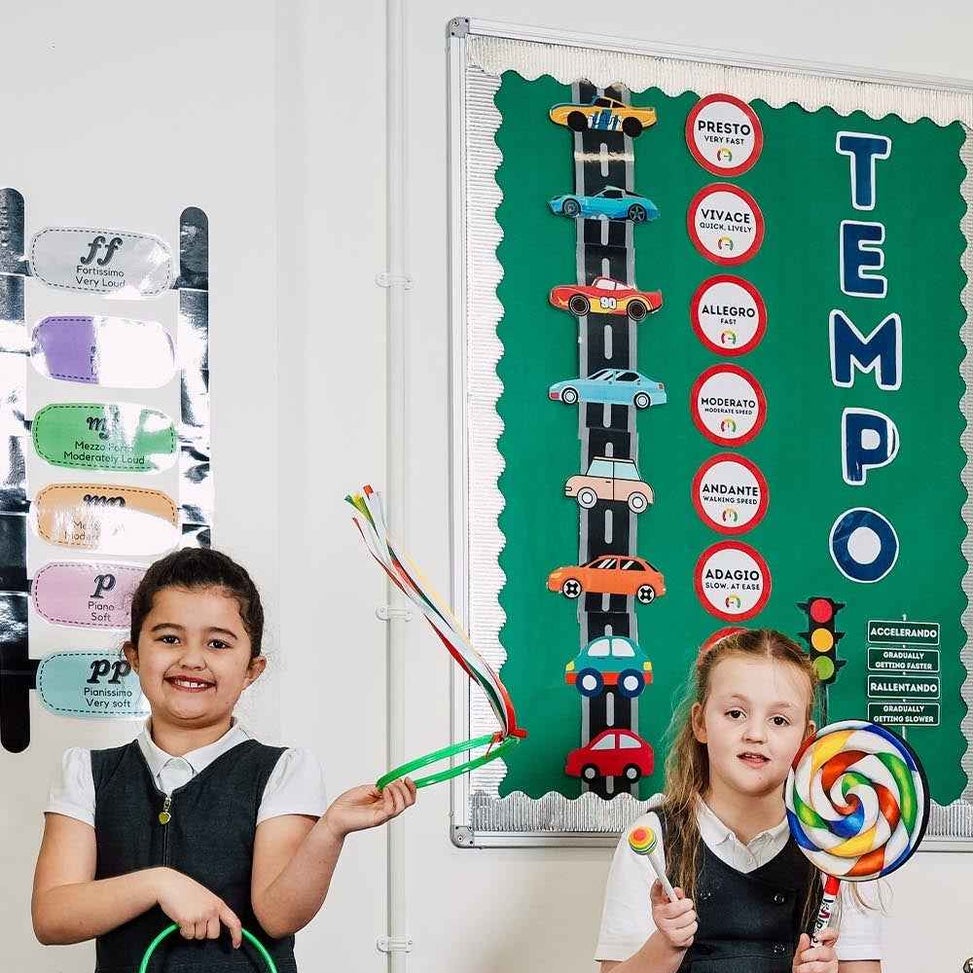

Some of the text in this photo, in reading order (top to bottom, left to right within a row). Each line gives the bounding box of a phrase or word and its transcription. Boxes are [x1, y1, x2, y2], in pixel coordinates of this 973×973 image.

[698, 120, 751, 136] PRESTO
[704, 135, 745, 145] VERY FAST
[701, 208, 750, 224] VIVACE
[727, 225, 752, 233] LIVELY
[80, 235, 124, 266] ff
[76, 264, 125, 277] Fortissimo
[75, 276, 100, 287] Very
[600, 296, 617, 310] 90
[701, 304, 756, 318] ALLEGRO
[720, 318, 737, 326] FAST
[829, 130, 903, 585] TEMPO
[701, 397, 756, 409] MODERATO
[704, 407, 753, 416] MODERATE SPEED
[63, 451, 118, 464] Moderately
[702, 484, 759, 497] ANDANTE
[703, 496, 735, 504] WALKING
[705, 568, 760, 581] ADAGIO
[90, 573, 116, 599] p
[741, 583, 761, 591] EASE
[88, 601, 115, 611] Piano
[91, 611, 111, 622] Soft
[870, 627, 938, 639] ACCELERANDO
[882, 651, 925, 660] GRADUALLY
[875, 661, 933, 670] GETTING FASTER
[86, 659, 132, 685] pp
[83, 687, 133, 698] Pianissimo
[870, 682, 938, 693] RALLENTANDO
[86, 698, 131, 709] Very soft
[883, 705, 925, 713] GRADUALLY
[873, 715, 934, 723] GETTING SLOWER
